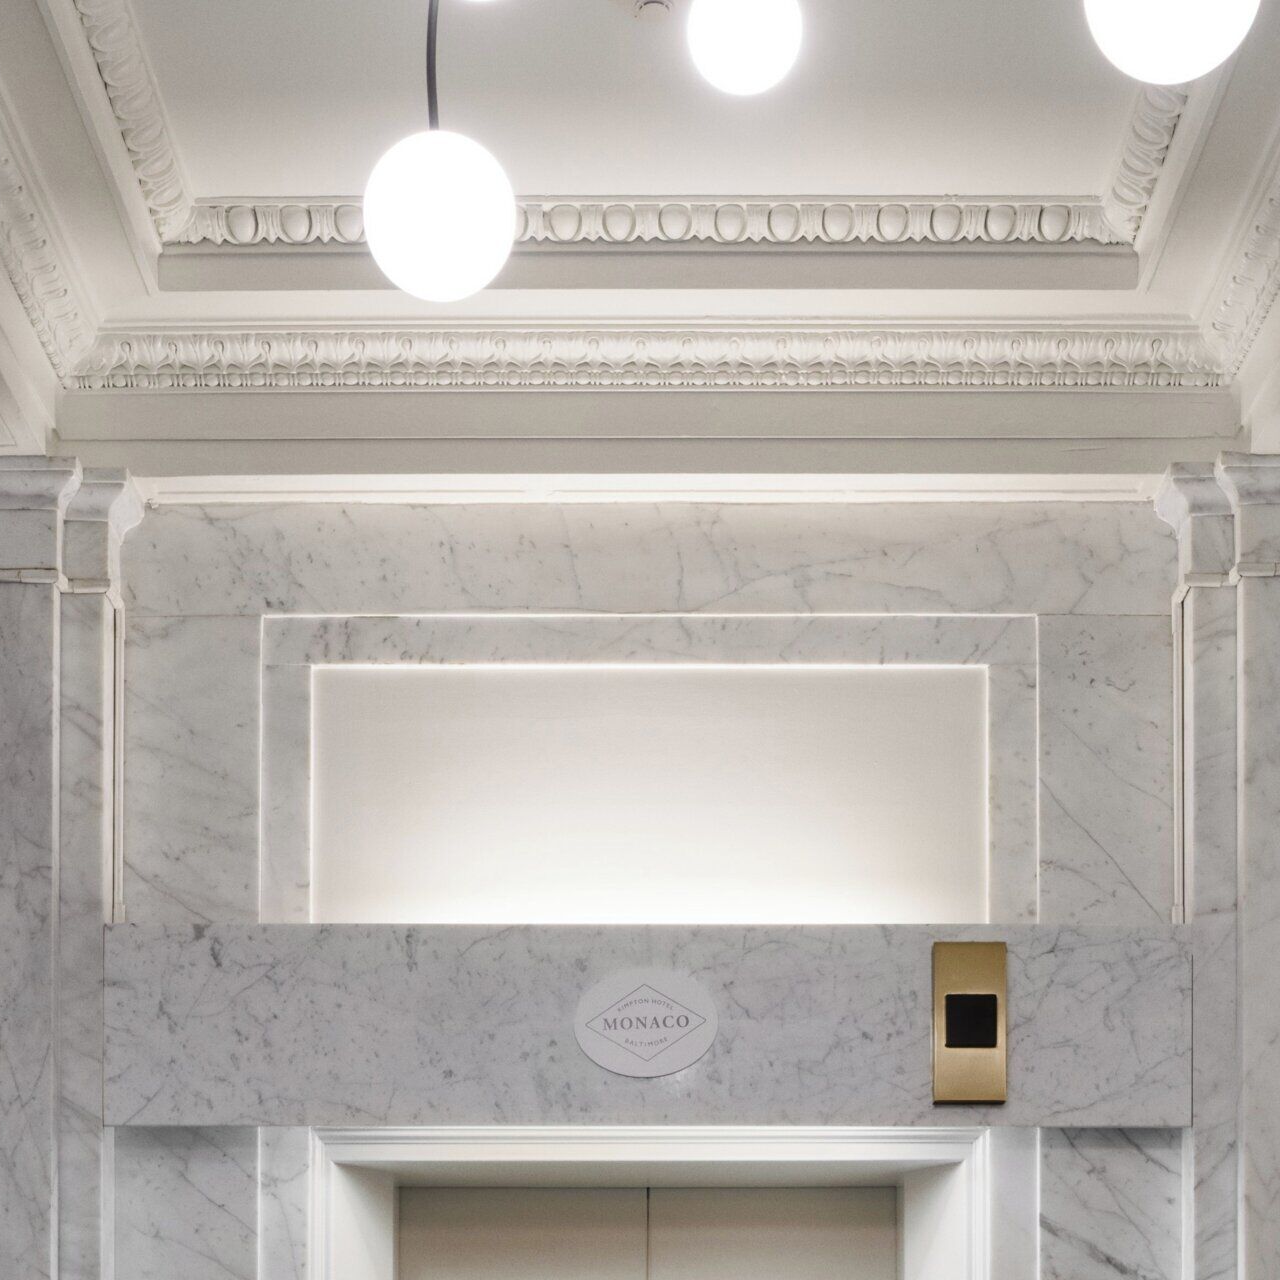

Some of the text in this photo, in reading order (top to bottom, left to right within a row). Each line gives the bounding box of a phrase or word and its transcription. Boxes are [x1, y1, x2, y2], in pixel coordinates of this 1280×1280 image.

[651, 999, 674, 1010] HOTEL
[603, 1014, 690, 1030] MONACO
[624, 1037, 668, 1047] BALTIMORE
